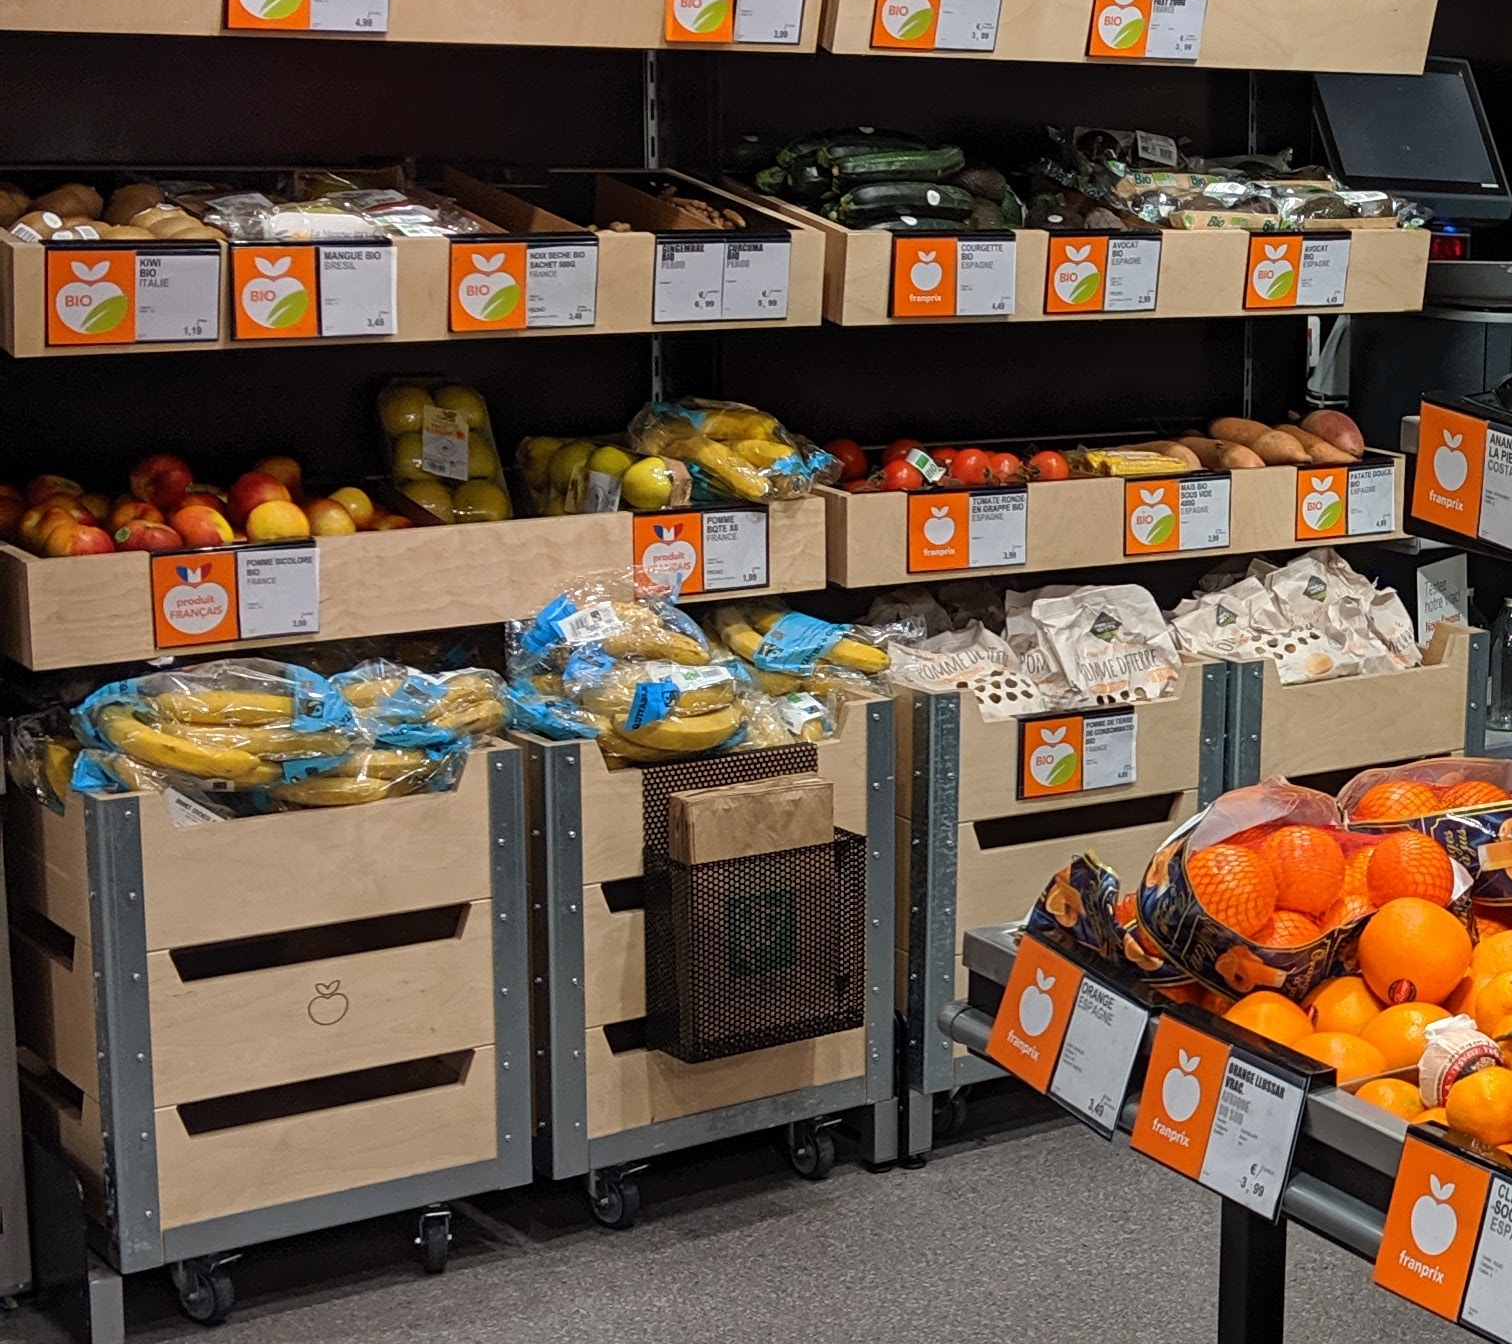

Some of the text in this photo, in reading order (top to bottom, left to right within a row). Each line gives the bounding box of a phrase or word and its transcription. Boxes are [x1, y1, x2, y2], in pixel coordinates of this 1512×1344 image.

[888, 5, 908, 16] BIO
[1104, 16, 1122, 26] BIO
[1206, 216, 1226, 228] Bio
[961, 244, 1003, 252] COURGETTE
[1112, 241, 1139, 249] AVOCAT
[324, 251, 381, 260] MANGUE BIO
[573, 251, 585, 259] BIO
[139, 258, 161, 267] KIWI
[324, 261, 356, 270] BRESIL
[530, 261, 557, 269] SACHET
[961, 261, 994, 269] ESPAGNE
[139, 268, 156, 277] BIO
[1059, 273, 1078, 282] BIO
[1258, 270, 1274, 279] BIO
[139, 278, 169, 288] ITALIE
[466, 285, 490, 296] BIO
[65, 295, 93, 307] BIO
[250, 290, 276, 302] BIO
[909, 293, 942, 303] franprix
[1489, 447, 1499, 459] LA
[1351, 472, 1371, 480] PATATE
[972, 496, 1000, 505] TOMATE
[1429, 489, 1464, 511] franprix
[983, 504, 1010, 512] GRAPPE
[1307, 501, 1323, 511] BIO
[707, 516, 735, 524] POMME
[1136, 515, 1154, 524] BIO
[707, 533, 737, 542] FRANCE
[247, 577, 276, 585] FRANCE
[176, 595, 214, 608] produit
[170, 607, 222, 619] FRANÇAIS
[1036, 755, 1054, 766] BIO
[1081, 982, 1116, 1011] ORANGE
[1078, 995, 1114, 1027] ESPAGNE
[1007, 1030, 1040, 1062] franprix
[1228, 1062, 1254, 1085] ORANGE
[1152, 1117, 1190, 1148] franprix
[1399, 1250, 1445, 1284] franprix
